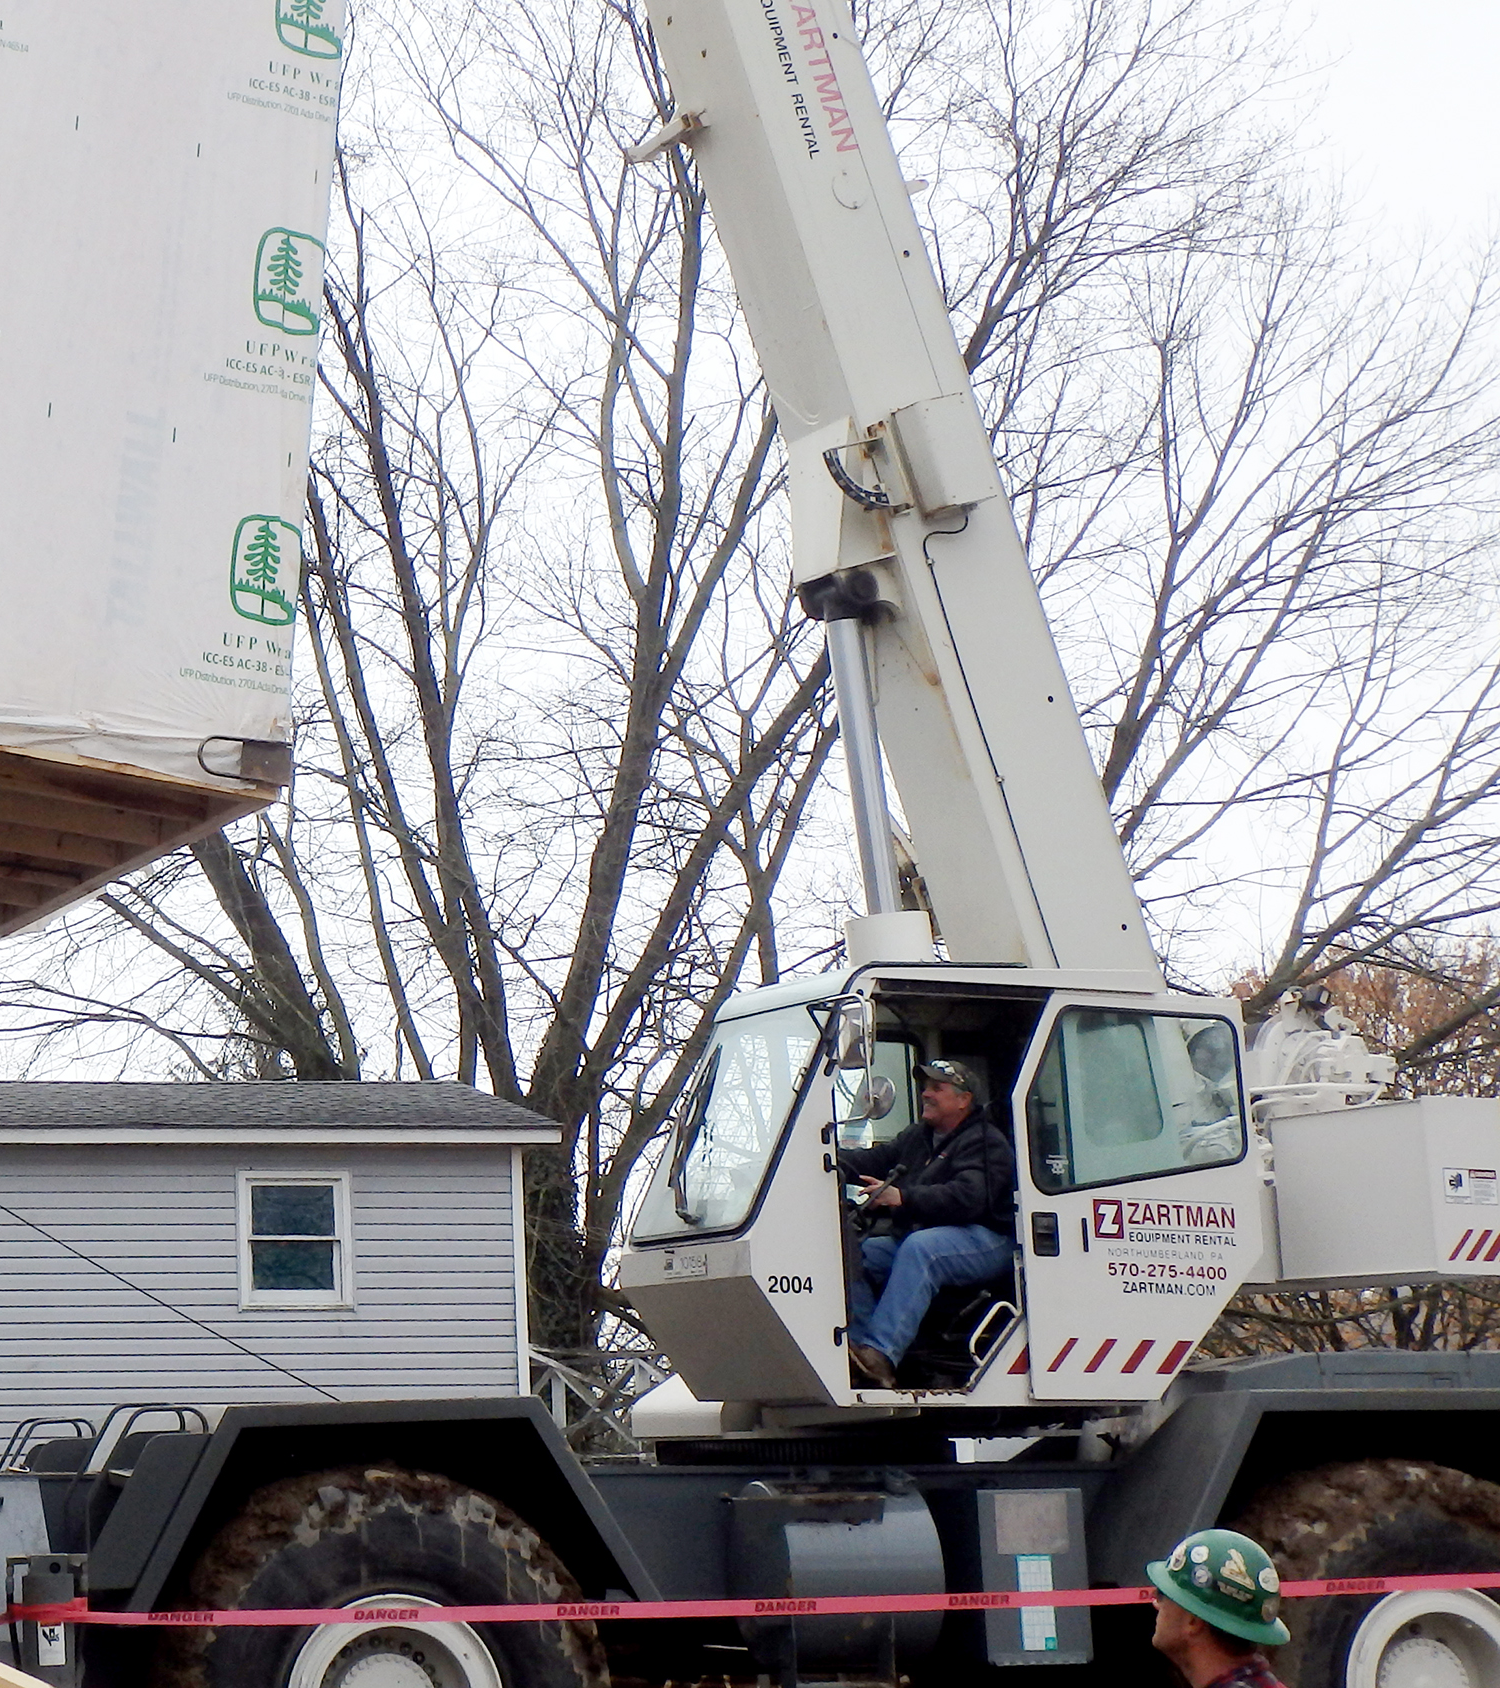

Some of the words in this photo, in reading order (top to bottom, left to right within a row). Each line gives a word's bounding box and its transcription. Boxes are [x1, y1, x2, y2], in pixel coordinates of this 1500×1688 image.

[269, 61, 301, 79] UFP
[790, 0, 858, 152] ARTMAN
[761, 0, 799, 85] QUIPMENT
[791, 94, 820, 160] RENTAL
[249, 78, 280, 92] ICC-ES
[283, 86, 310, 100] AC-38
[246, 340, 280, 356] UFP
[226, 358, 257, 373] ICC-ES
[223, 632, 258, 650] UFP
[203, 652, 234, 666] ICC-ES
[237, 659, 267, 672] AC-38
[1127, 1202, 1235, 1228] ZARTMAN
[1129, 1232, 1190, 1244] EQUIPMENT
[1195, 1235, 1236, 1246] RENTAL
[1211, 1252, 1223, 1260] PA
[1108, 1263, 1227, 1280] 570-275-4400
[768, 1275, 813, 1294] 2004
[1123, 1282, 1216, 1296] ZARTMAN.COM
[1326, 1580, 1385, 1591] DANGER
[755, 1601, 817, 1613] DANGER
[949, 1595, 1009, 1606] DANGER
[148, 1612, 214, 1622] DANGER
[354, 1609, 419, 1621] DANGER
[557, 1605, 620, 1616] DANGER
